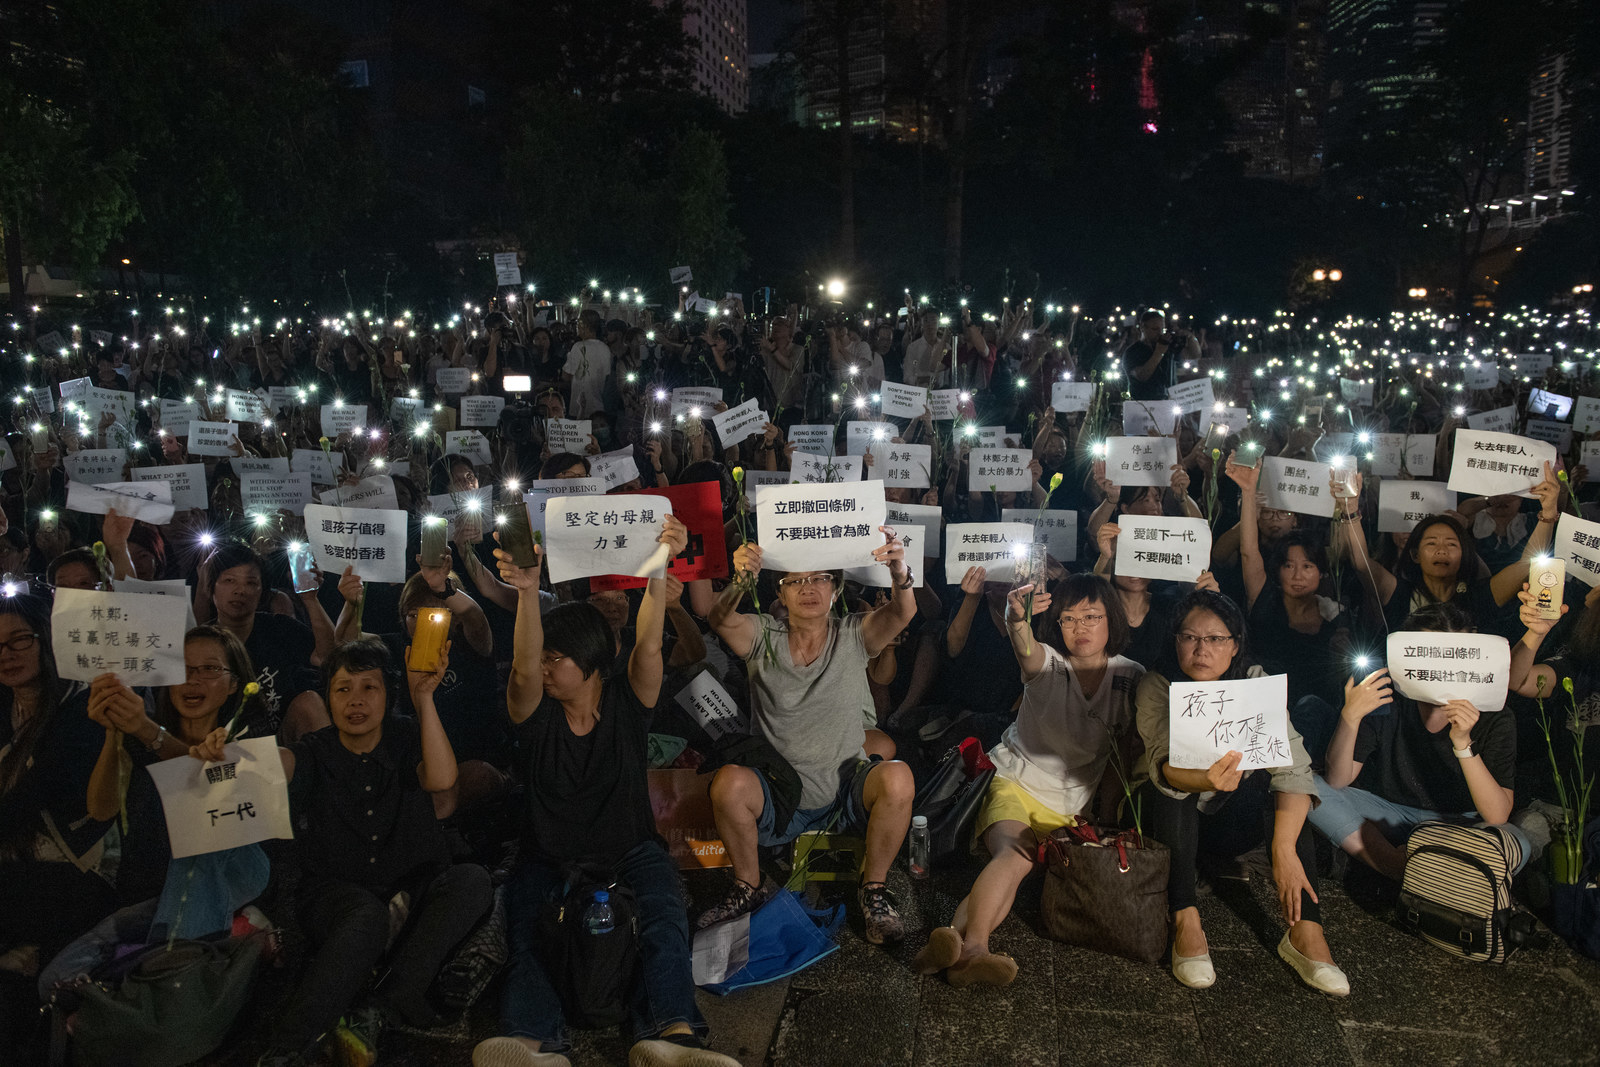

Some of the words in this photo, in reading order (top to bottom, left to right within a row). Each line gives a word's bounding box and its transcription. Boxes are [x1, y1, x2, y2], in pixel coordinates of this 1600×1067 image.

[904, 389, 922, 397] SHOOT
[892, 400, 913, 408] PEOPLE!
[889, 451, 912, 462] 為母
[1131, 444, 1152, 455] 停止
[1474, 441, 1534, 457] 失去年輕人，
[72, 455, 118, 464] 不要將社會
[982, 454, 1020, 463] 林鄭才是
[1121, 460, 1164, 471] 白色恐怖
[888, 468, 911, 480] 則強
[978, 467, 1024, 477] 最大的暴力
[1284, 465, 1311, 479] 團結，
[1466, 457, 1540, 478] 香港還剩下什麼
[365, 487, 385, 497] WILL
[546, 485, 568, 493] STOP
[569, 485, 597, 493] BEING
[1277, 481, 1320, 497] 就有希望
[774, 498, 865, 515] 立即撤回條例，
[565, 508, 656, 527] 堅定的母親
[321, 519, 385, 535] 還孩子值得
[775, 524, 871, 541] 不要與社會為敵
[593, 535, 628, 550] 力量
[962, 533, 1013, 543] 失去年輕人，
[1133, 527, 1197, 543] 愛護下一代，
[324, 544, 385, 560] 珍愛的香港
[958, 551, 1014, 562] 香港還剩下什
[1133, 551, 1191, 566] 不要開槍！
[1403, 646, 1489, 660] 立即撤回條例，
[1404, 668, 1494, 684] 不要與社會為敵
[694, 702, 710, 718] LAM
[701, 694, 726, 721] VIOLENT
[1180, 689, 1235, 718] 孩子
[206, 802, 256, 827] 下一代
